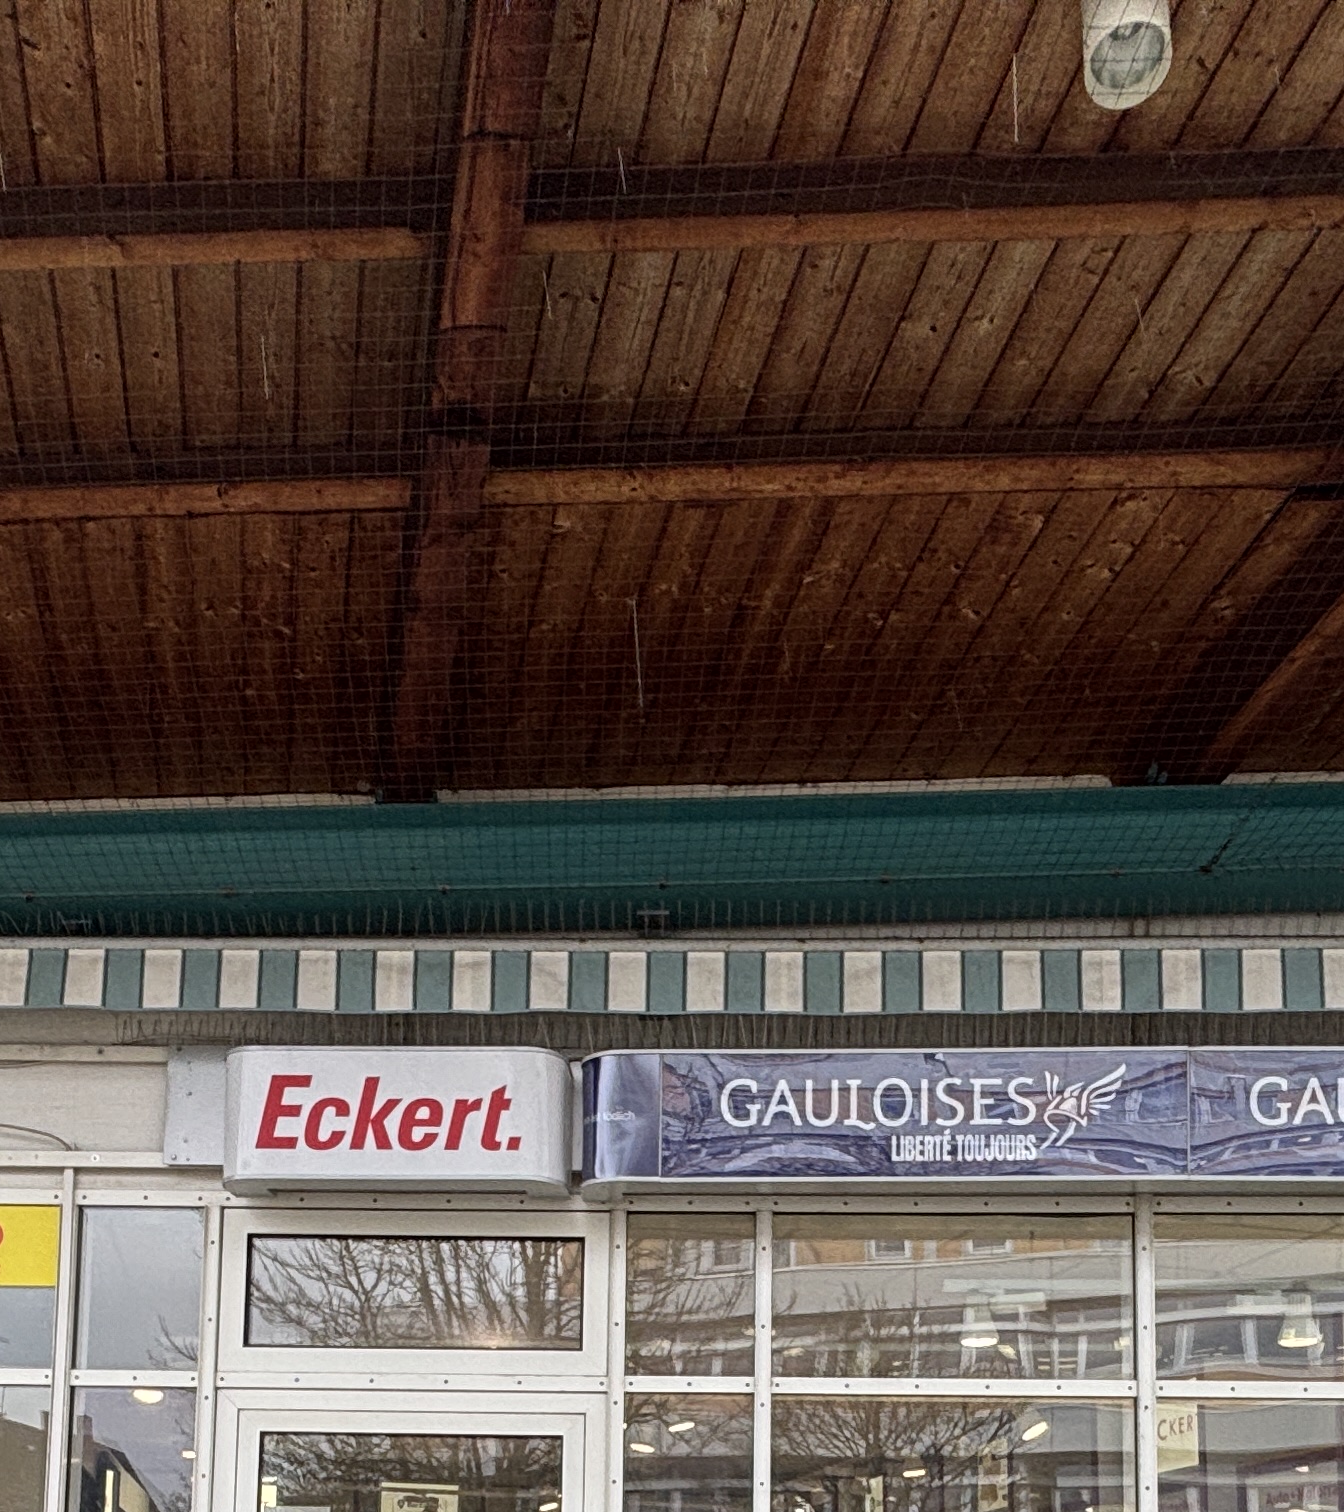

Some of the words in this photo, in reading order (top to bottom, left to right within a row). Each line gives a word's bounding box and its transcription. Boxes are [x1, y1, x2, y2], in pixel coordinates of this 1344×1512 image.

[253, 1074, 521, 1152] Eckert.
[720, 1076, 1037, 1132] GAULOISES
[891, 1129, 953, 1162] LIBERTÉ
[956, 1134, 1037, 1162] TOUJOURS
